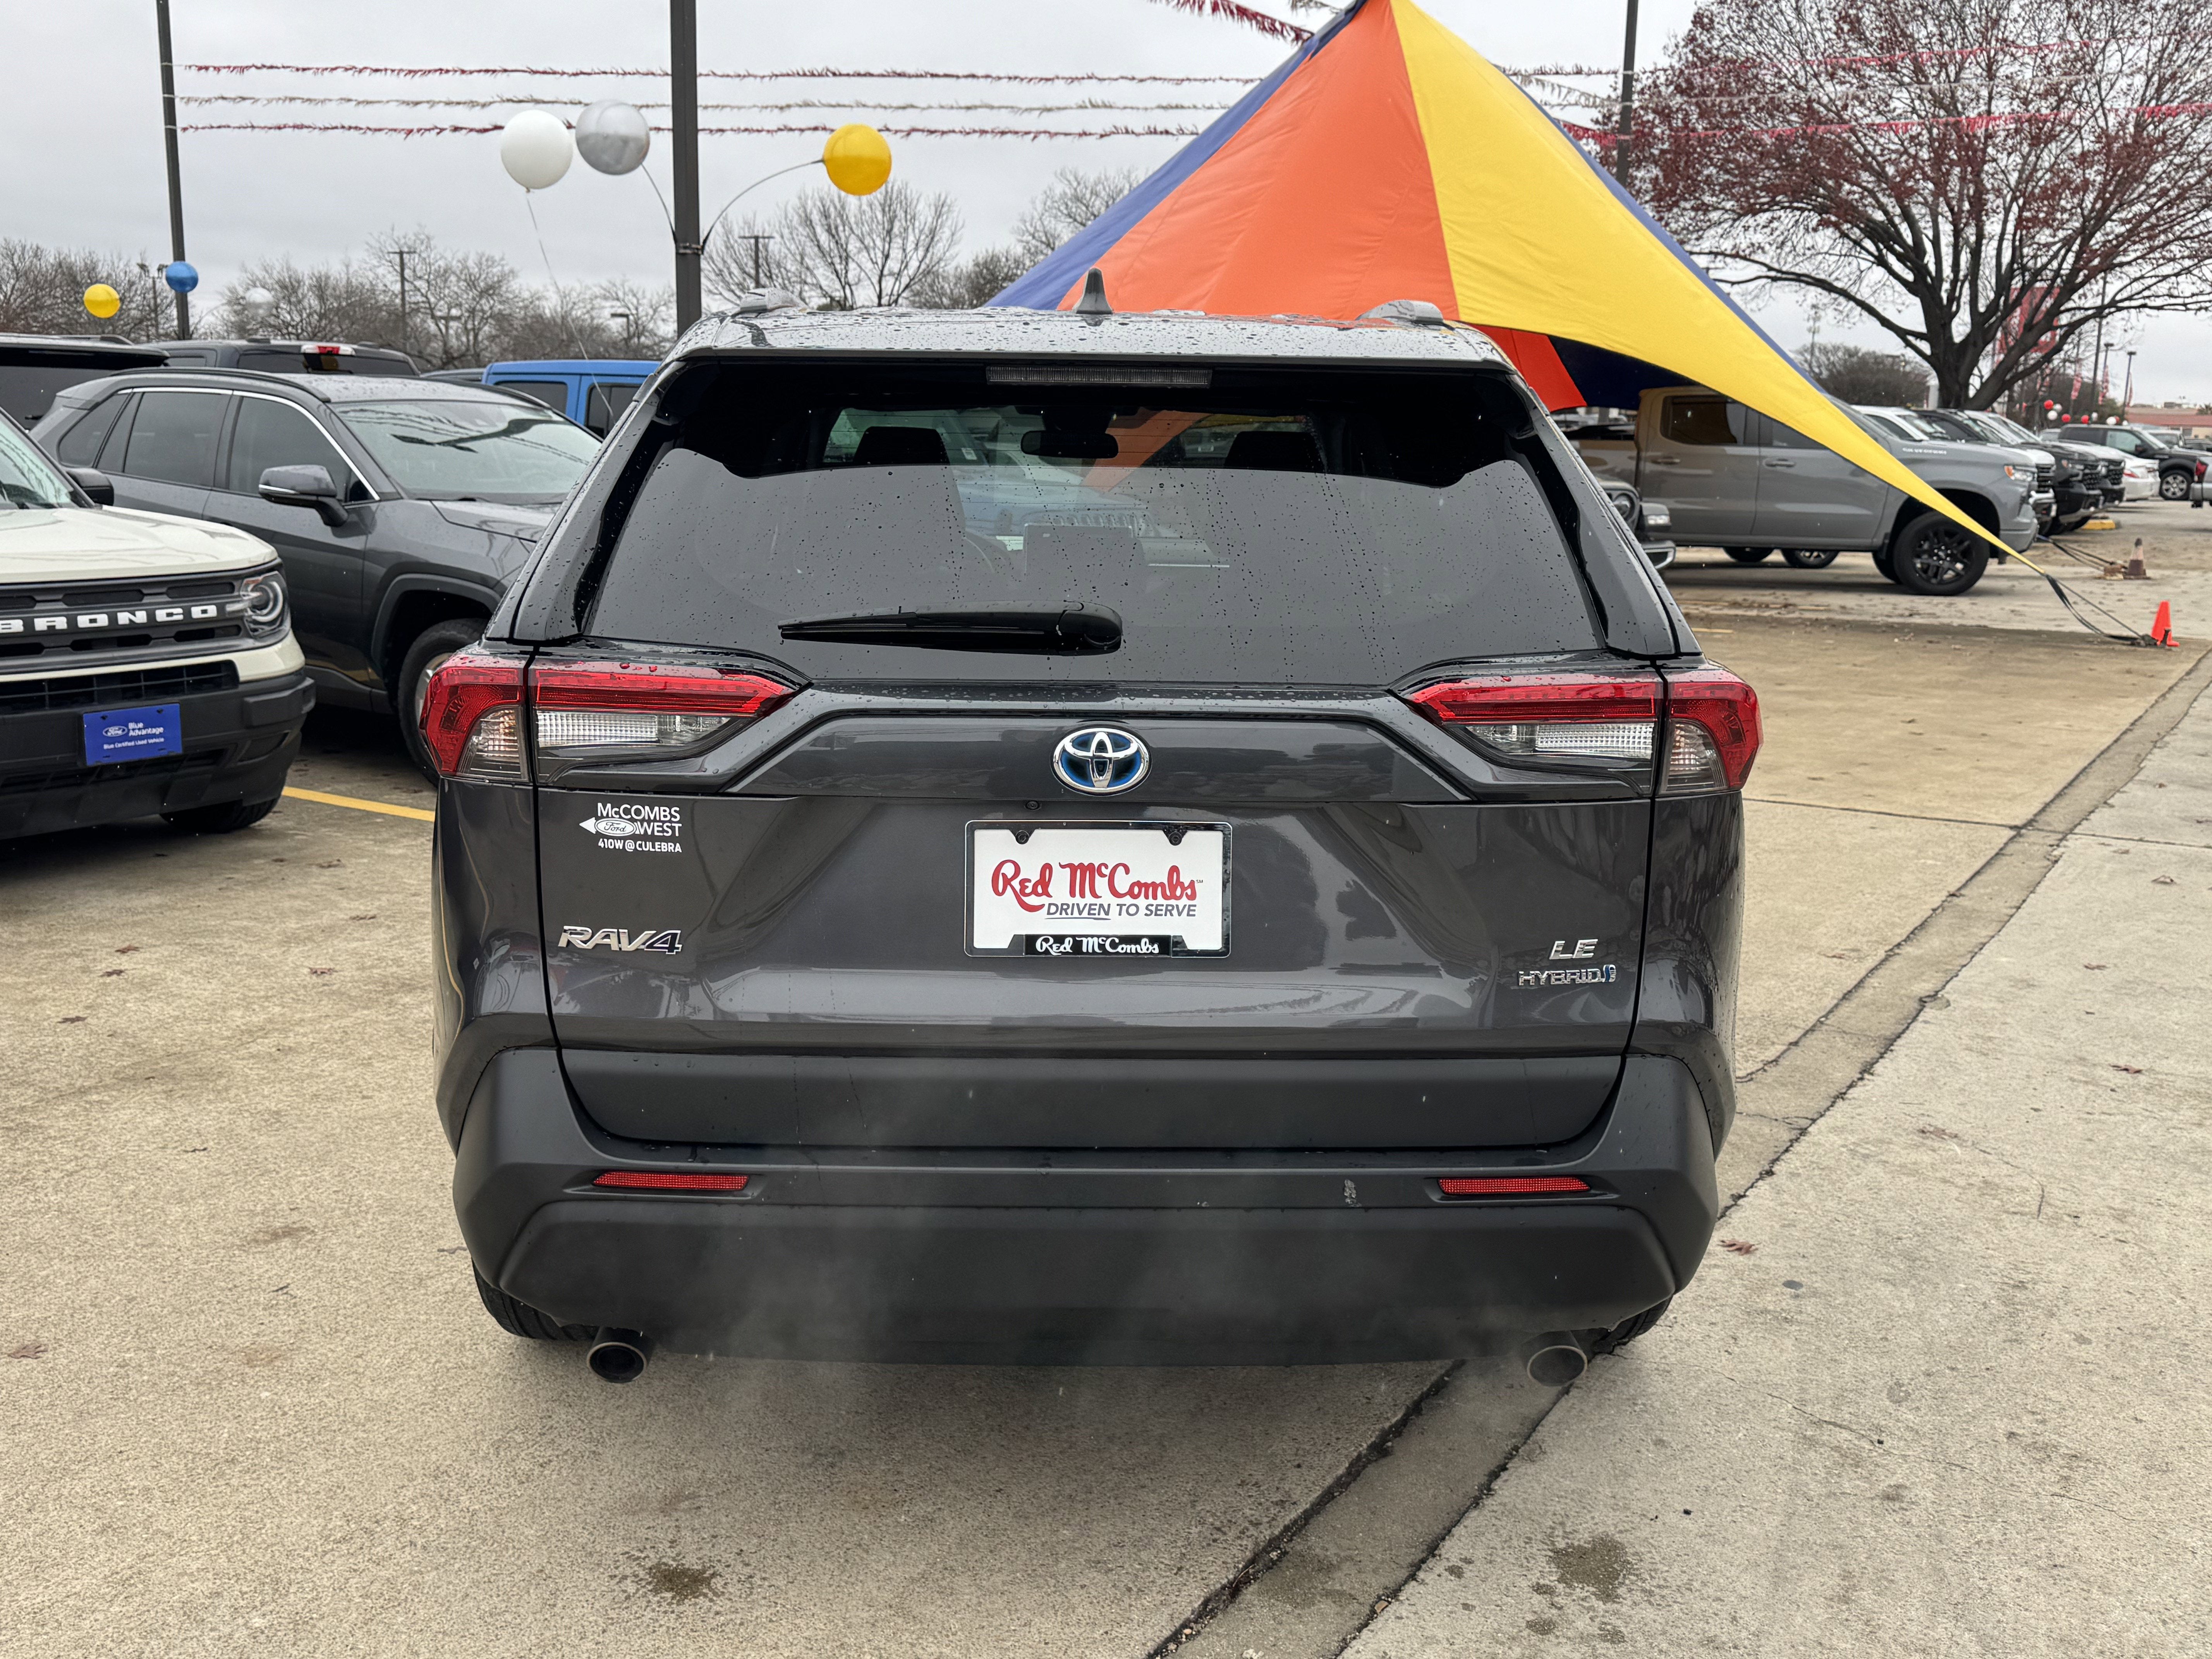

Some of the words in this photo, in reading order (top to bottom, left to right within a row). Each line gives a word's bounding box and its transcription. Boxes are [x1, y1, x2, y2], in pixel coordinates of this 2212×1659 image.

[0, 605, 217, 633] BRONCO
[129, 727, 164, 737] Advantage
[597, 802, 681, 822] McCOMBS
[604, 822, 627, 833] Ford
[635, 821, 682, 837] WEST
[991, 859, 1053, 912] Red
[1059, 862, 1197, 901] McCombs
[1046, 903, 1111, 916] DRIVEN
[1116, 903, 1140, 917] TO
[1144, 903, 1197, 917] SERVE
[558, 925, 683, 955] RAV4
[1036, 936, 1073, 956] Red
[1075, 936, 1159, 954] McCombs
[1549, 939, 1598, 960] LE
[1518, 968, 1602, 986] HYBRID
